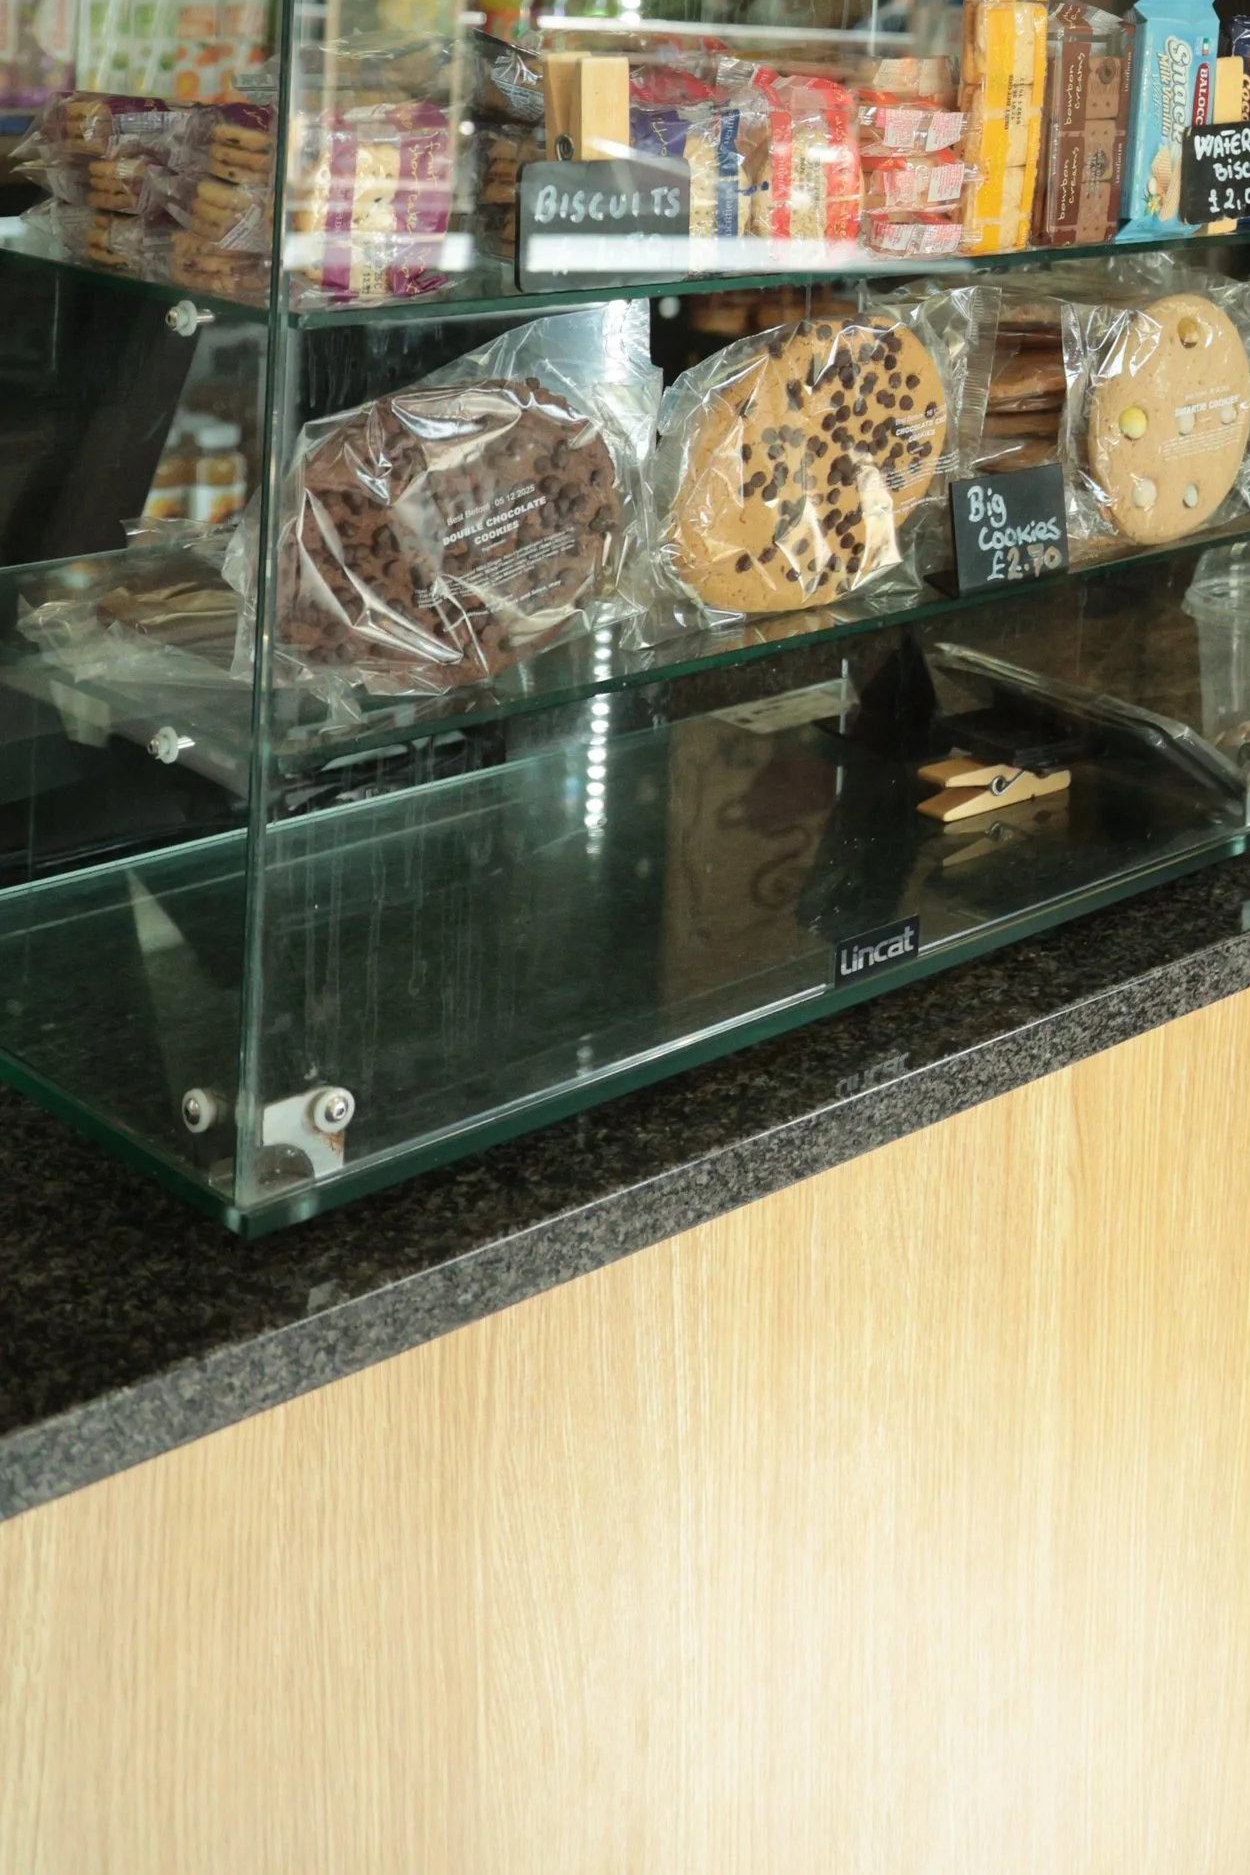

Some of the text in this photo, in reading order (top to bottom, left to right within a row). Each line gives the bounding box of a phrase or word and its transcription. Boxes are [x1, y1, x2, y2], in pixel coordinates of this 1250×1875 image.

[1064, 64, 1076, 126] bourbon
[1074, 51, 1086, 110] creams
[1157, 52, 1173, 140] Milk Vanilla
[1165, 35, 1193, 145] Snack
[1057, 158, 1070, 221] bourbon
[1068, 145, 1080, 204] creams
[534, 184, 681, 223] BISCUITS
[895, 419, 934, 436] CHOCOLATE
[442, 495, 547, 546] DOUBLE CHOCOLATE
[474, 520, 520, 545] COOKIES
[967, 485, 1007, 528] Big
[986, 542, 1062, 582] £2.70
